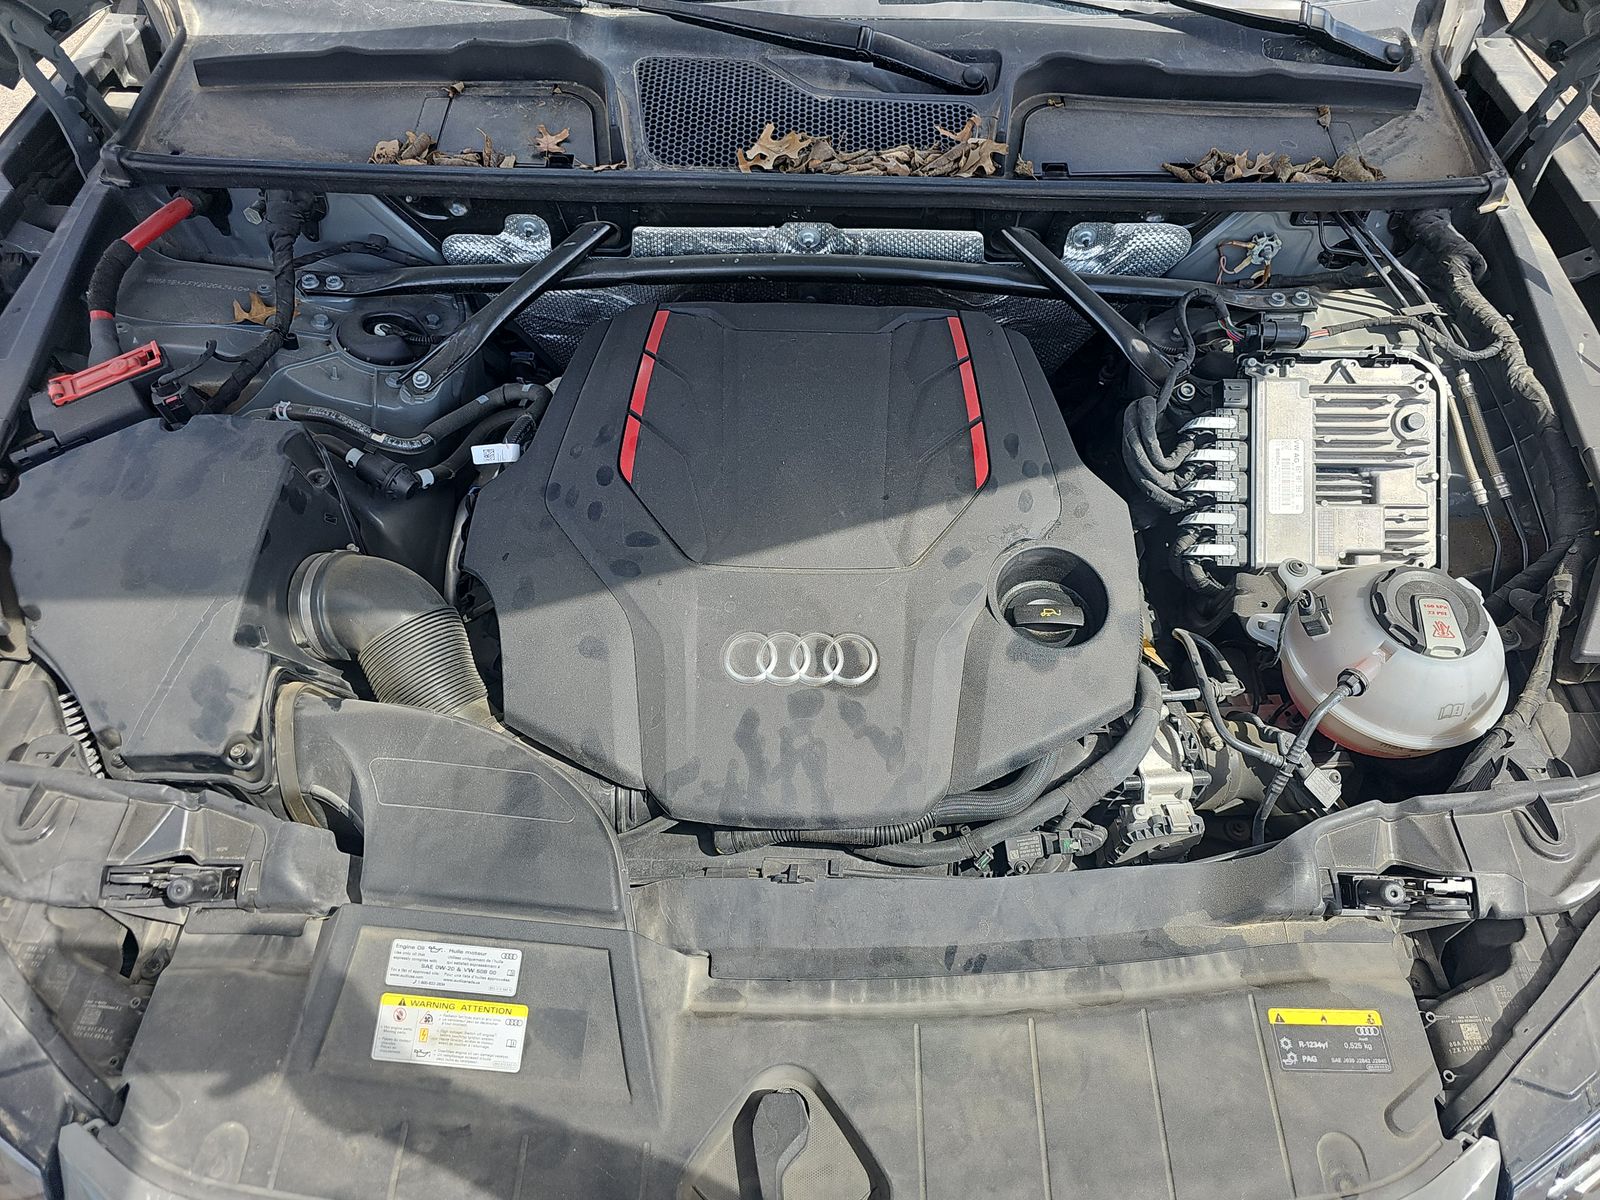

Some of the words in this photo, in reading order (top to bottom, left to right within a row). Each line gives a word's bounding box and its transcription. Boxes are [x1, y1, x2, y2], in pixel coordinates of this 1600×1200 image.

[395, 942, 416, 950] Engine
[410, 1000, 456, 1010] WARNING
[460, 1004, 513, 1015] ATTENTION
[1344, 1042, 1362, 1050] 0,525
[1364, 1042, 1373, 1050] kg
[1302, 1055, 1318, 1063] PAG
